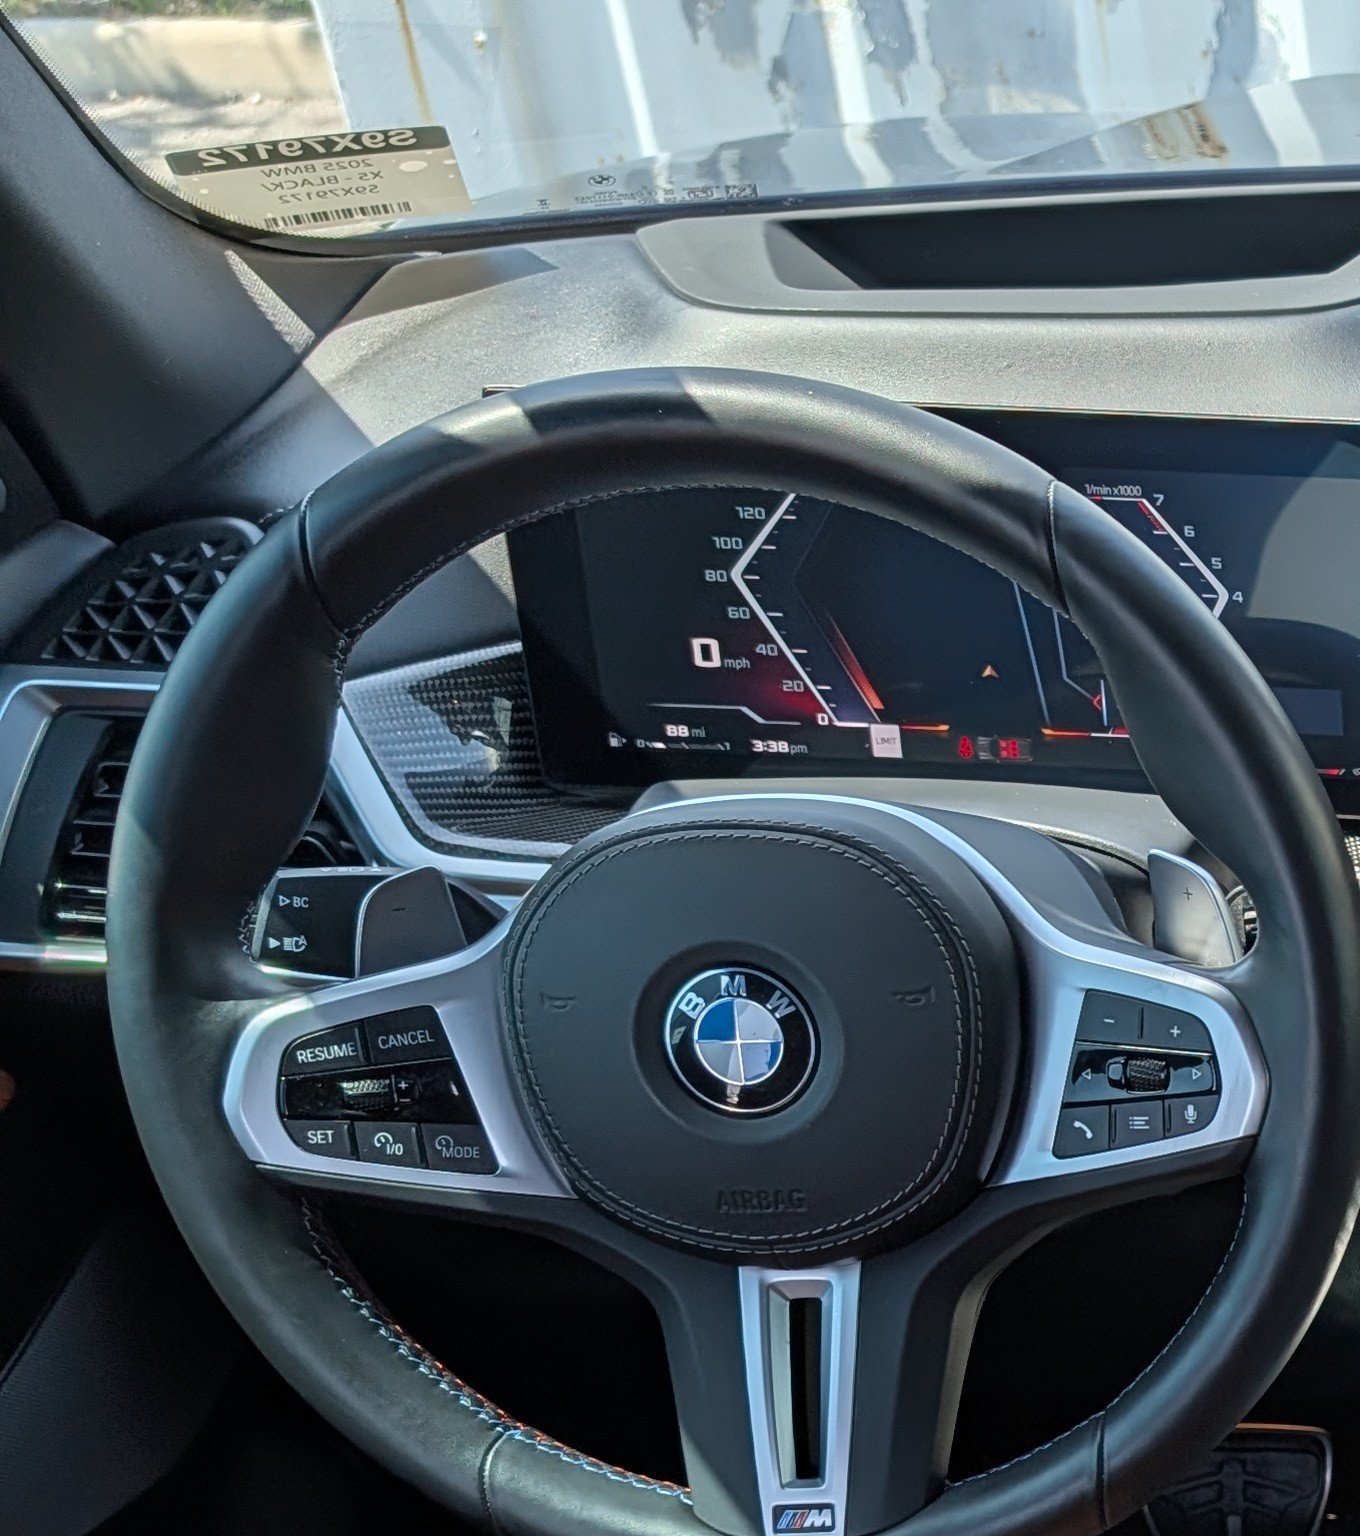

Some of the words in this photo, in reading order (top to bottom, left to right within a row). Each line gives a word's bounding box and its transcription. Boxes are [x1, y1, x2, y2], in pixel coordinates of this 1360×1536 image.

[1152, 493, 1165, 507] 7
[735, 506, 766, 520] 120
[1184, 525, 1195, 537] 6
[712, 536, 743, 550] 100
[1211, 557, 1222, 569] 5
[704, 569, 728, 583] 80
[1232, 591, 1245, 604] 4
[727, 606, 751, 620] 60
[690, 637, 722, 669] 0
[724, 656, 751, 670] mph
[755, 643, 779, 657] 40
[782, 679, 805, 693] 20
[816, 712, 829, 726] 0
[665, 724, 690, 738] 88
[691, 727, 706, 738] mi
[875, 736, 898, 746] LIMIT
[292, 895, 309, 908] BC
[677, 973, 797, 1020] BMW
[377, 1029, 435, 1050] CANCEL
[296, 1042, 357, 1064] RESUME
[307, 1130, 335, 1145] SET
[442, 1145, 481, 1159] MODE
